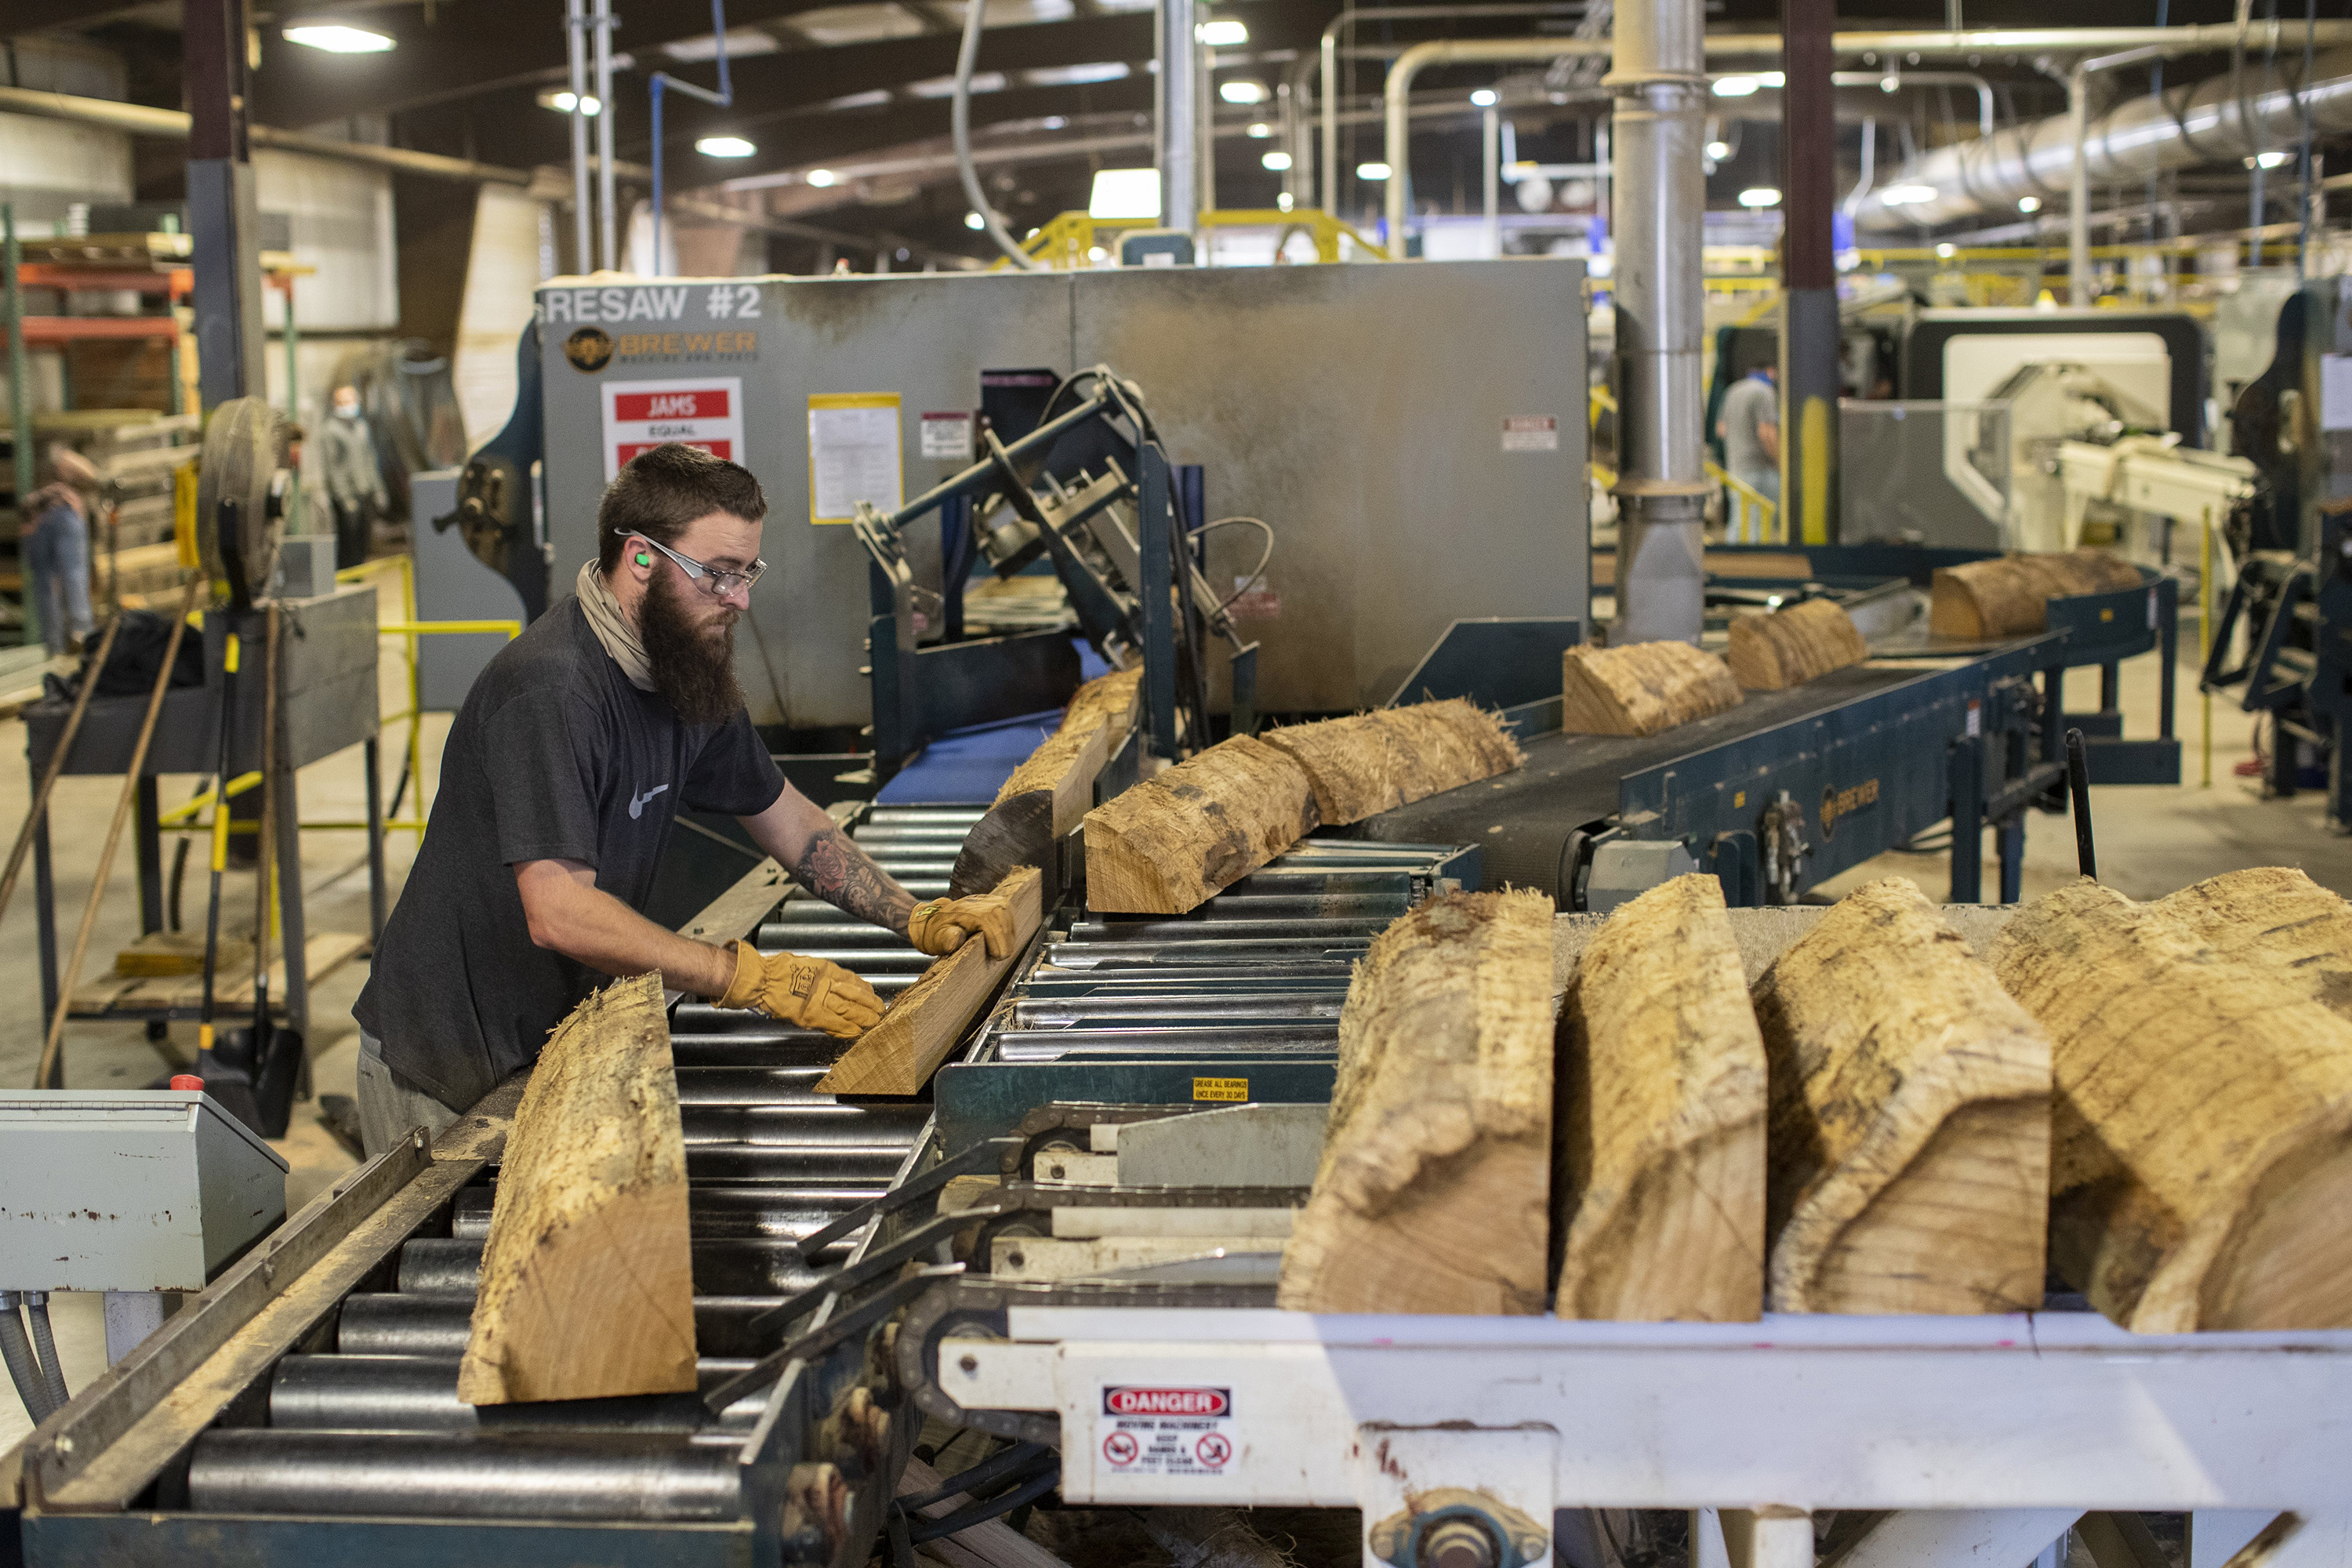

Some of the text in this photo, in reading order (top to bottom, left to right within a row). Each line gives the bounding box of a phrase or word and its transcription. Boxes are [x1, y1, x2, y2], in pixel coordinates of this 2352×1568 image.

[546, 285, 762, 322] RESAW #2
[619, 332, 756, 355] BREWER
[648, 394, 697, 418] JAMS
[648, 424, 697, 437] EQUAL
[1120, 1391, 1212, 1412] DANGER
[1116, 1421, 1155, 1429] MOVING
